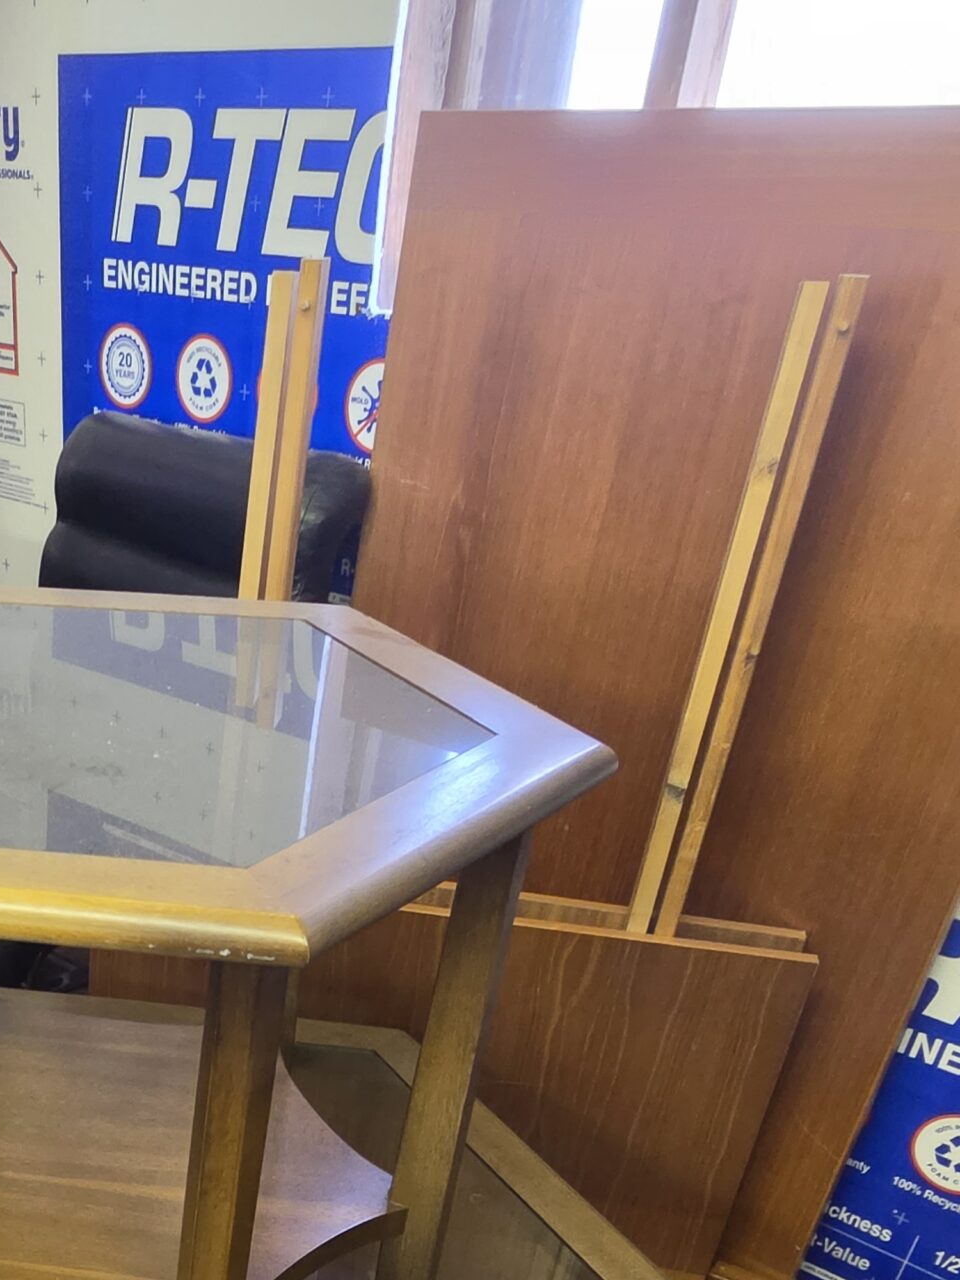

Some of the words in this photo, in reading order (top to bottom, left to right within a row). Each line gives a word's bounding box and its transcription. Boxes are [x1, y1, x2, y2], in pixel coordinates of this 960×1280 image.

[111, 106, 388, 265] R-TEC
[103, 258, 257, 304] ENGINEERED
[114, 367, 135, 380] YEARS
[118, 351, 133, 368] 20
[892, 1176, 922, 1197] 100%
[923, 1189, 960, 1214] Recyc
